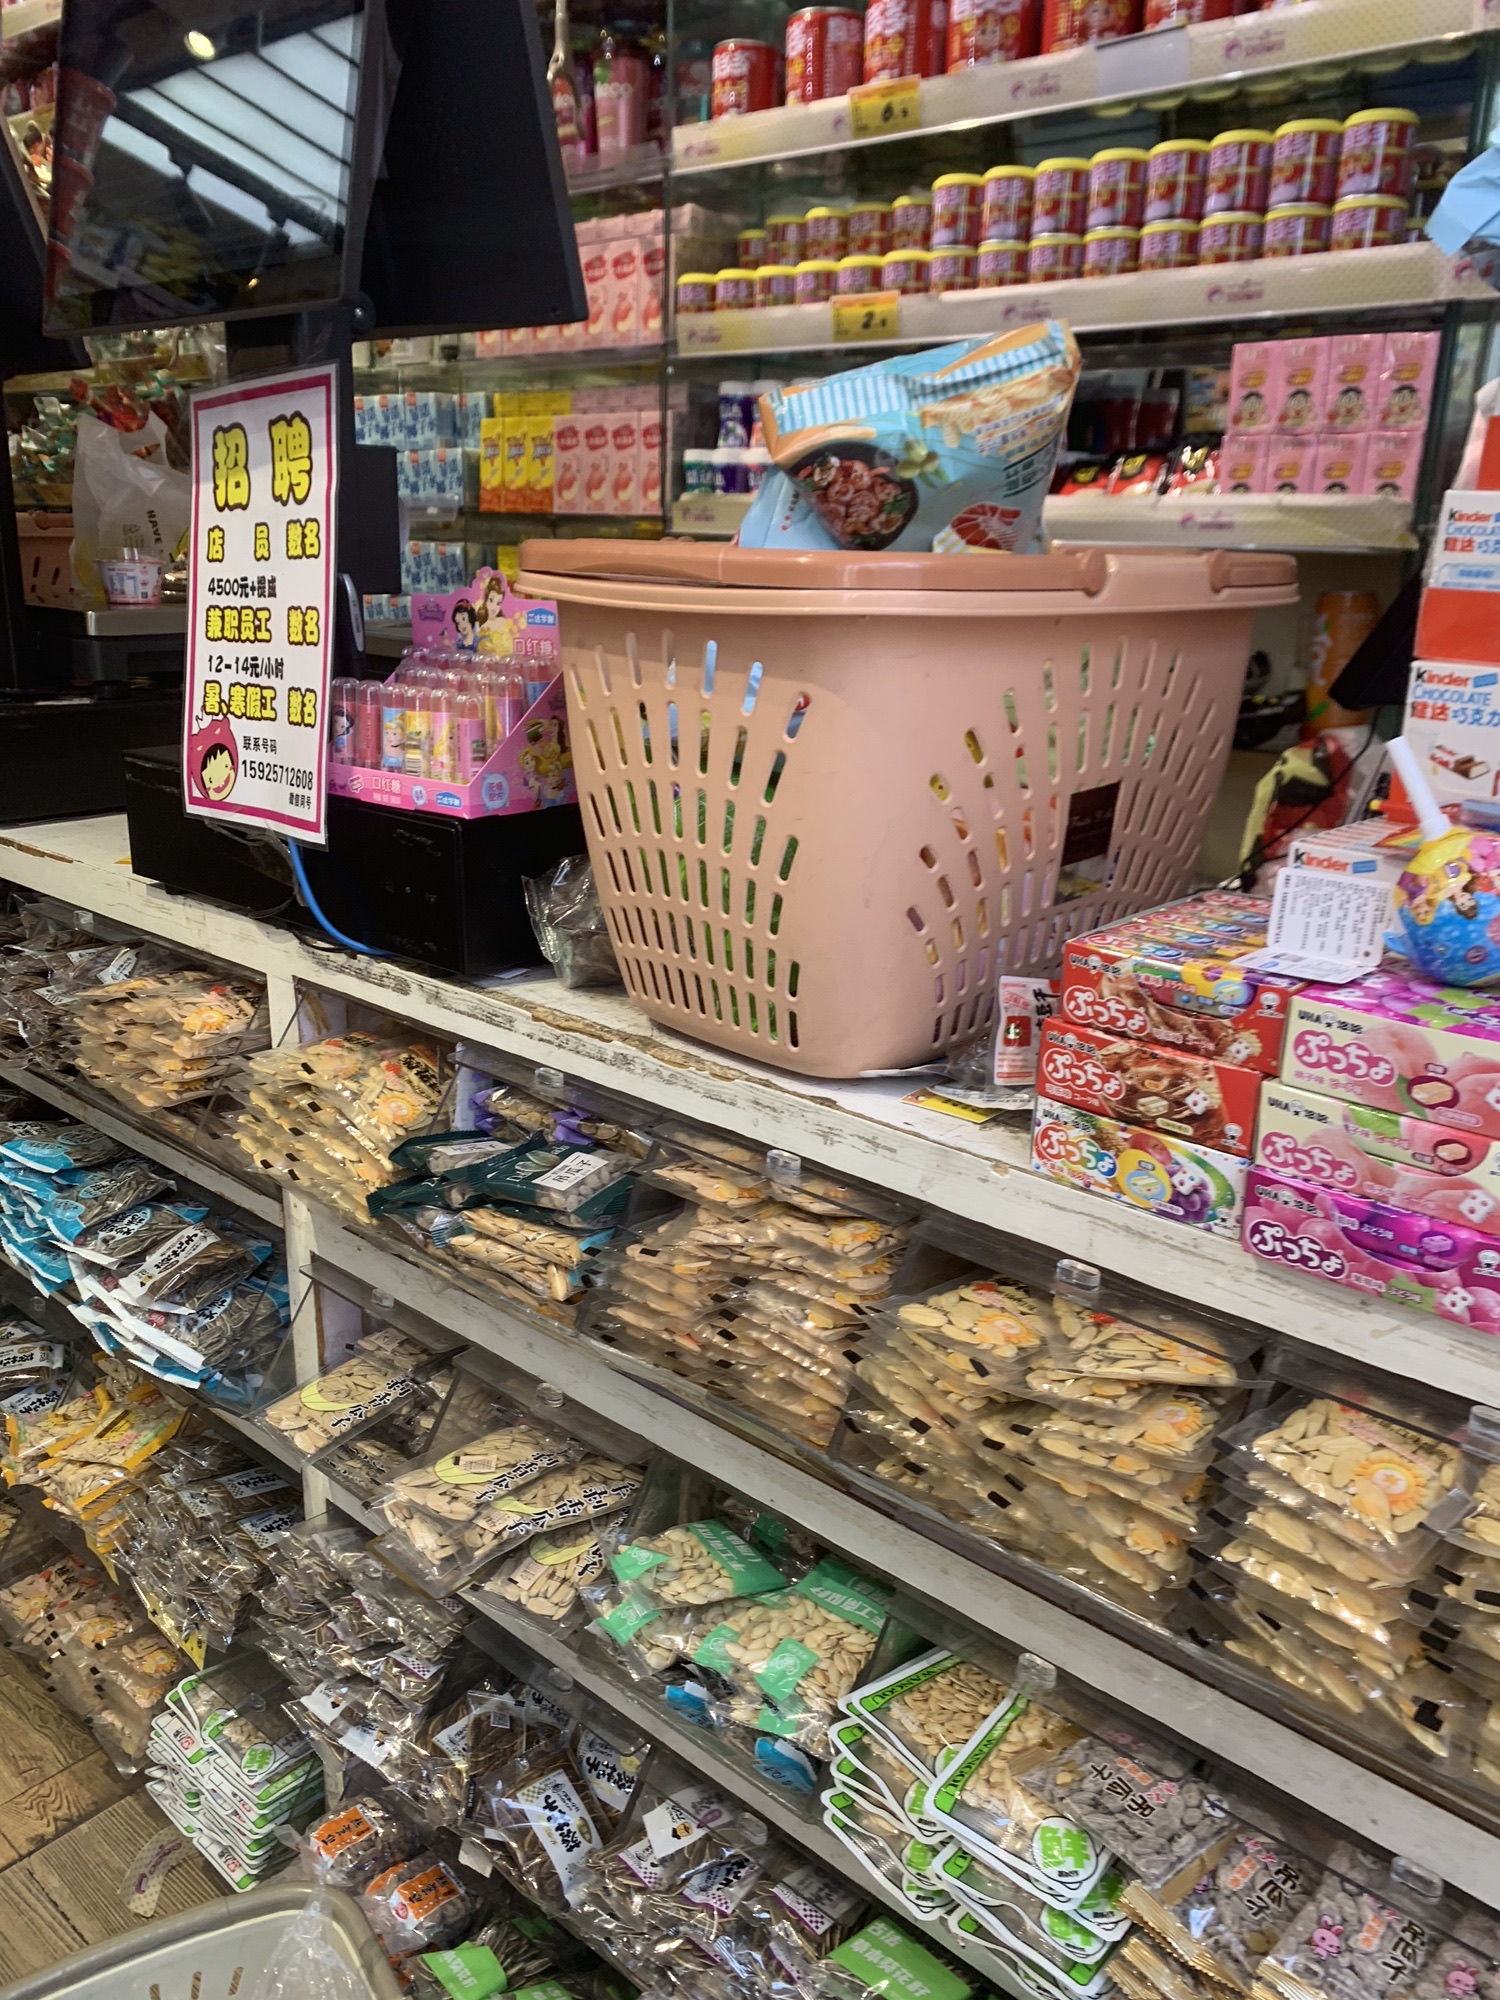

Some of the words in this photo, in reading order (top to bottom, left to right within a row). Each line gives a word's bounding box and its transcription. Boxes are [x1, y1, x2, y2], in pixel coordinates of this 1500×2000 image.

[207, 525, 225, 562] 店
[254, 522, 270, 561] 员
[287, 517, 320, 560] 数名
[207, 575, 277, 599] 4500元+提成
[205, 604, 272, 643] 兼职员工
[287, 605, 320, 646] 数名
[513, 637, 553, 657] 口红糖
[207, 654, 284, 680] 12-14元/小时
[1414, 667, 1471, 687] kinder
[287, 686, 318, 729] 数名
[1411, 683, 1493, 706] CHOCOLATE
[1410, 701, 1450, 722] 健达
[1451, 707, 1500, 727] 巧克力
[242, 735, 277, 754] 联系号码
[241, 760, 314, 790] 15925712608
[1294, 848, 1350, 872] kinder
[1066, 989, 1146, 1034] ぷっちょ
[1297, 1009, 1322, 1024] UHA
[1295, 1033, 1391, 1081] ぷっちょ
[1046, 1051, 1122, 1097] ぷっちょ
[1267, 1096, 1290, 1112] UHA
[1038, 1128, 1116, 1175] ぷっちょ
[1263, 1133, 1355, 1183] ぷっちょ
[1251, 1222, 1344, 1274] ぷっちょ
